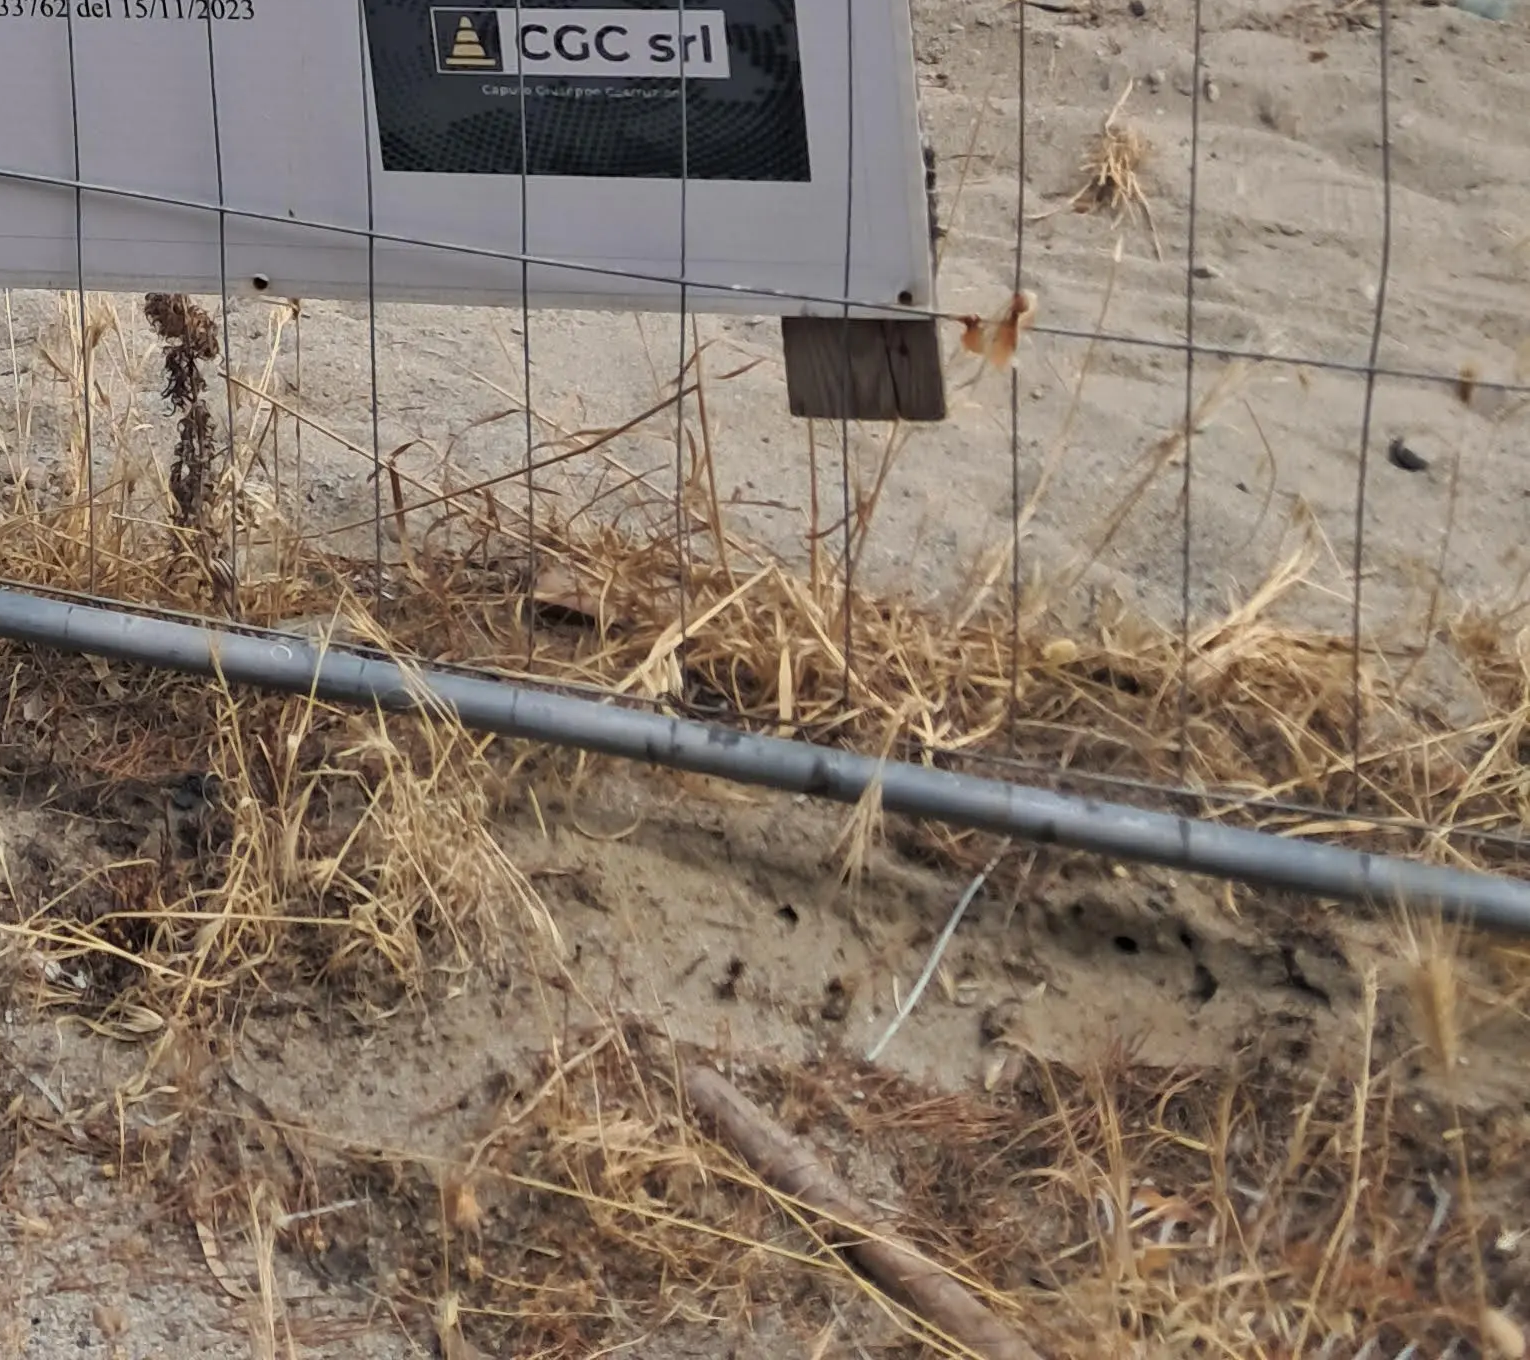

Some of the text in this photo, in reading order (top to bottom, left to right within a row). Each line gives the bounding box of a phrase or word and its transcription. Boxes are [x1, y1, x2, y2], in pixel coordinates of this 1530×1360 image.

[520, 23, 713, 64] CGC srl
[481, 84, 532, 97] Capuo
